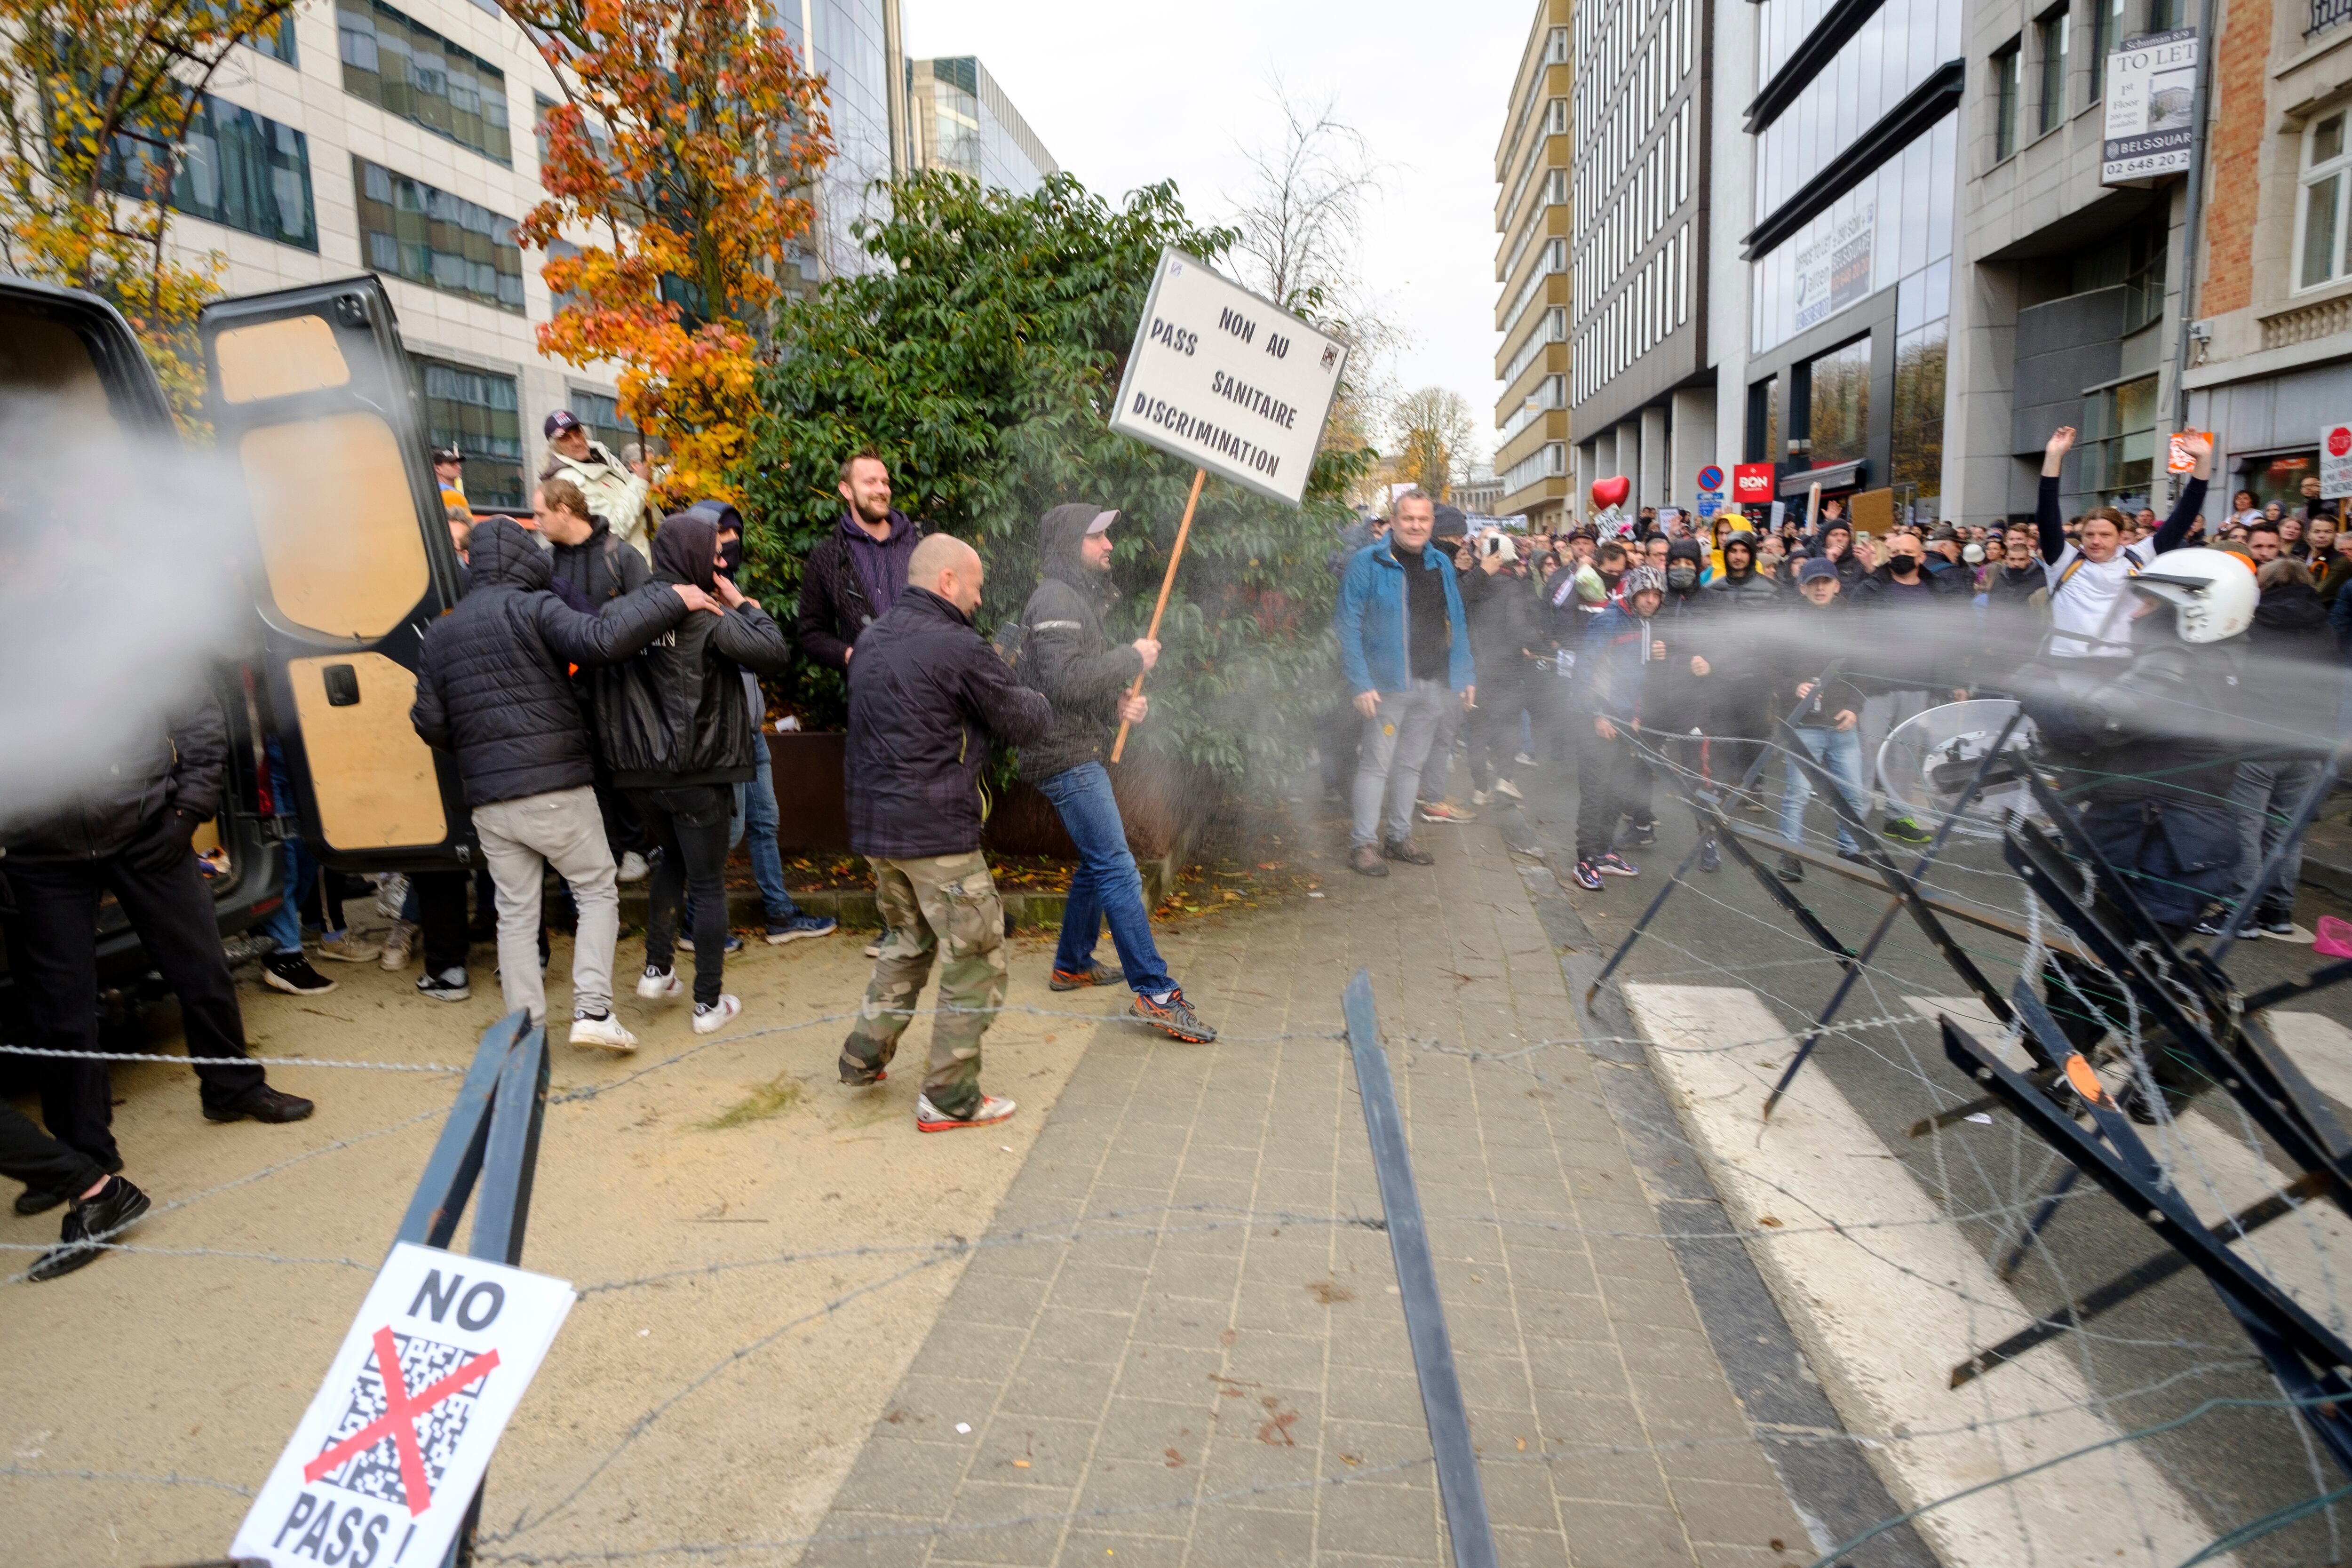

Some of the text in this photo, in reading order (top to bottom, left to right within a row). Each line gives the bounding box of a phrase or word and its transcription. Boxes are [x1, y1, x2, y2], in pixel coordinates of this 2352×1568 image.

[2117, 42, 2198, 72] TO LET
[2126, 30, 2189, 50] Schuman 8/9
[2113, 99, 2139, 110] Floor
[2121, 83, 2134, 96] 1st
[2120, 132, 2192, 154] BELSQUAR
[2107, 164, 2123, 175] 02
[2127, 158, 2153, 171] 648
[2159, 155, 2175, 166] 20
[2180, 152, 2190, 163] 2
[1833, 231, 1871, 269] BELSQUARE
[1150, 317, 1199, 357] PASS
[1218, 306, 1257, 345] NON
[1265, 332, 1290, 359] AU
[1211, 370, 1297, 430] SANITAIRE
[1132, 390, 1280, 478] DISCRIMINATION
[1739, 476, 1768, 488] BON
[406, 1268, 505, 1331] NO
[272, 1491, 389, 1568] PASS
